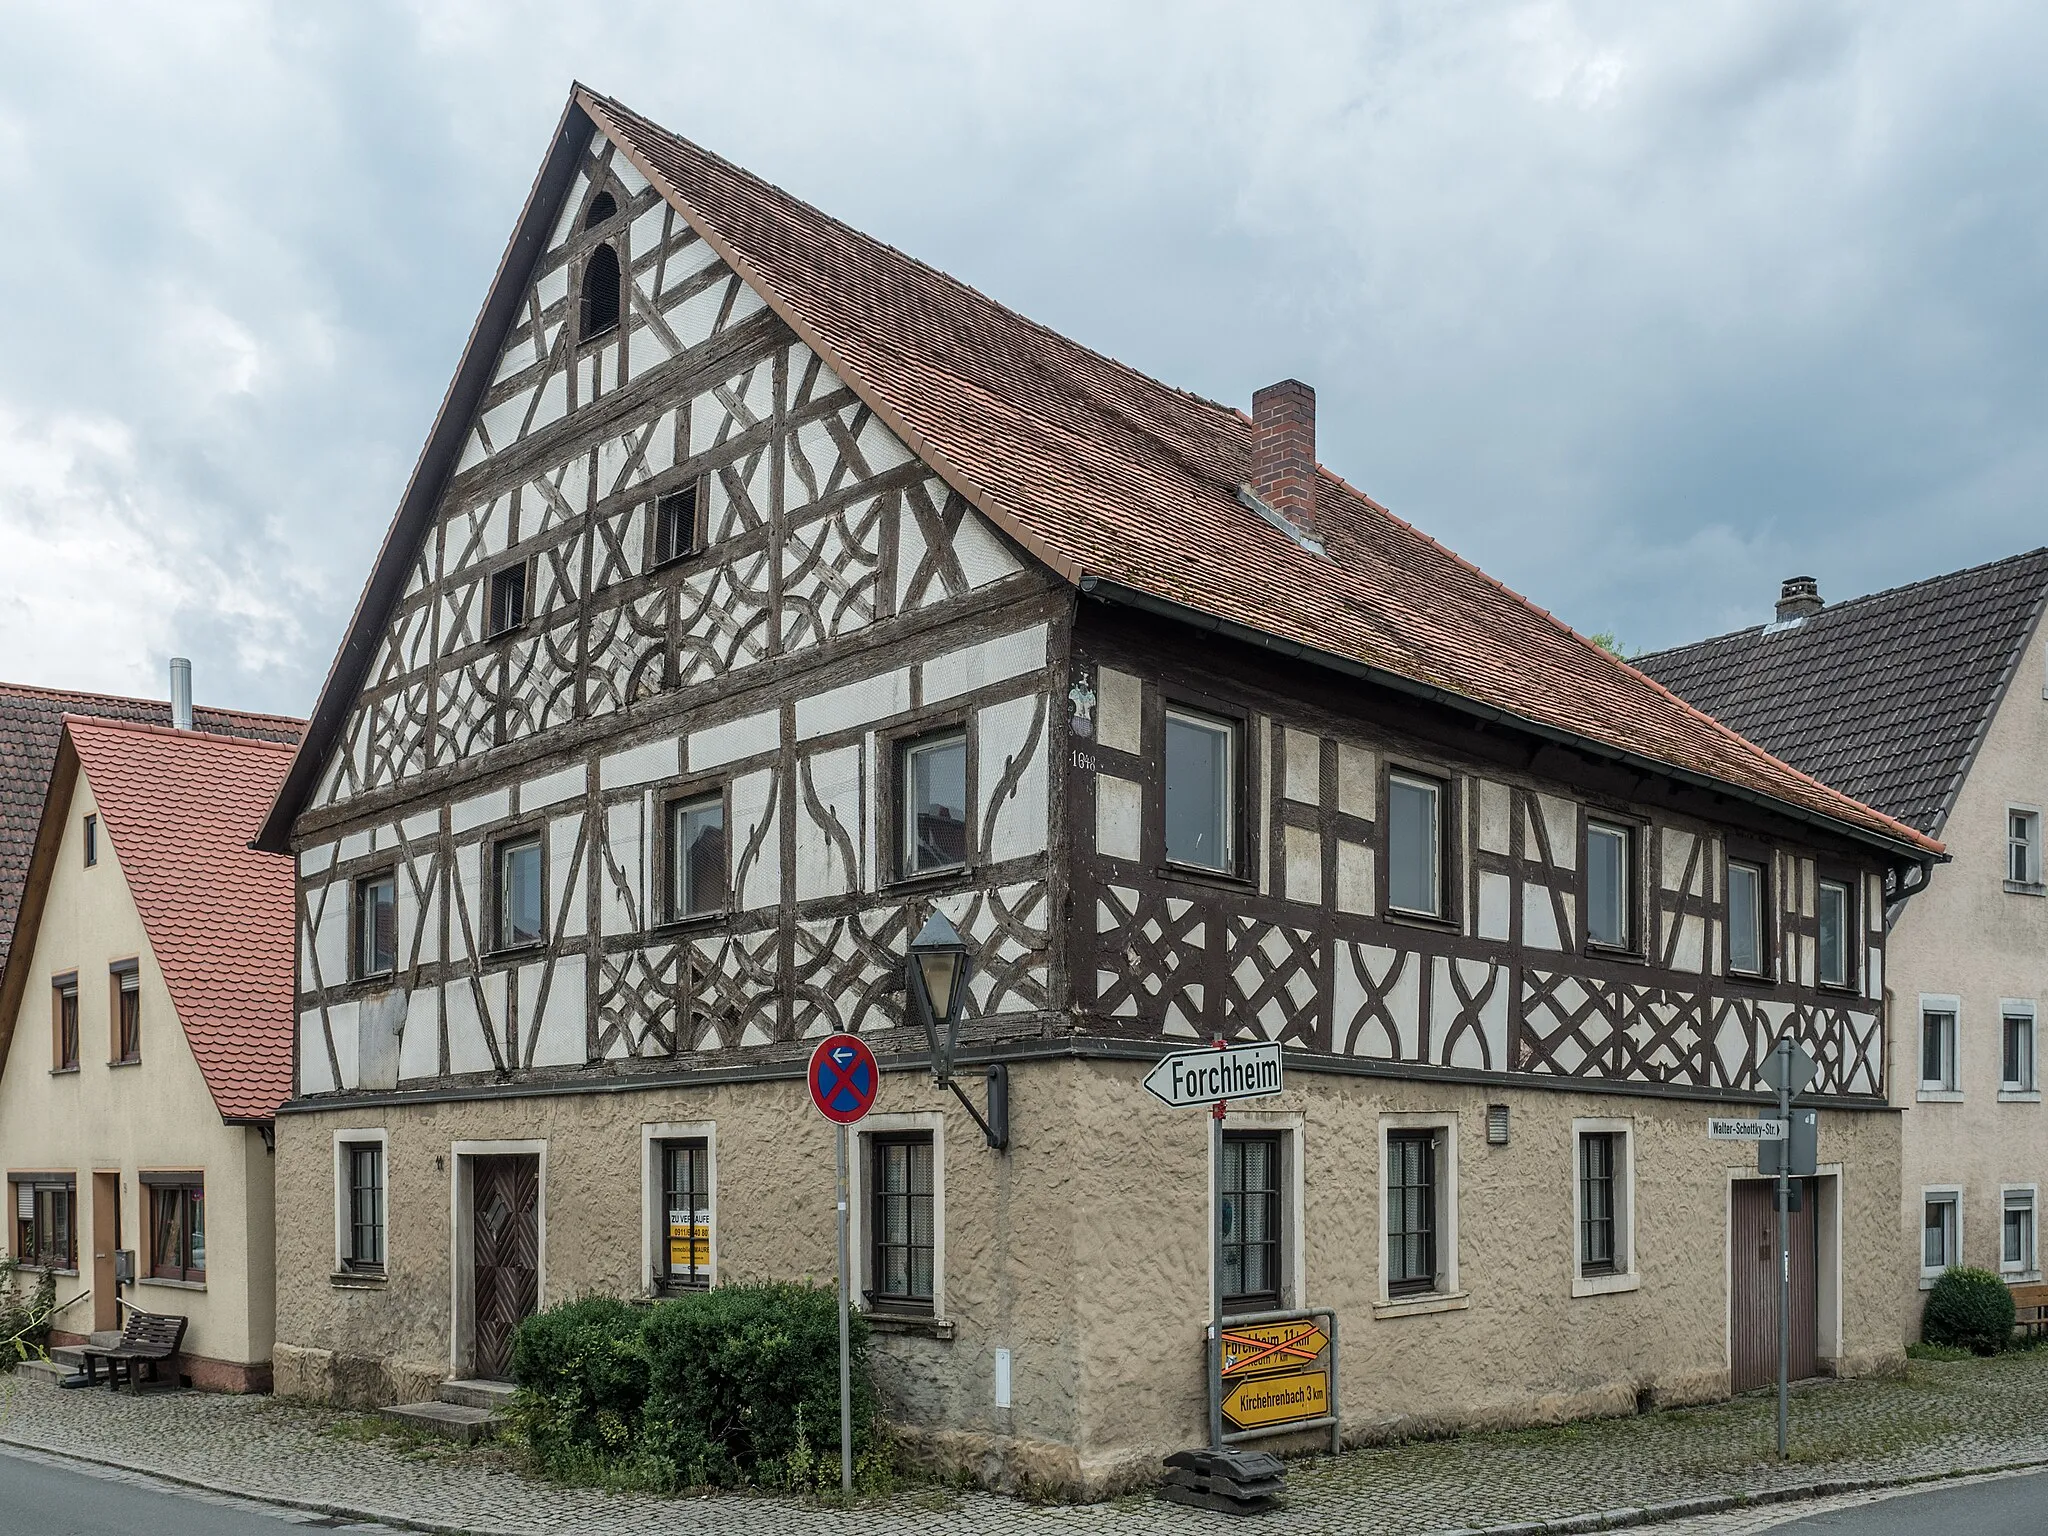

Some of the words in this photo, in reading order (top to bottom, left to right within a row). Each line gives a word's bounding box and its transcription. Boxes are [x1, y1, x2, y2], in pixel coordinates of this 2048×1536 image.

[1072, 750, 1096, 772] 1648
[1172, 1052, 1278, 1100] Forchheim
[1712, 1121, 1776, 1138] Walter-Schottky-Str.
[1284, 1329, 1294, 1347] 11
[1240, 1386, 1305, 1412] Kirchehrenbach
[1306, 1385, 1312, 1401] 3
[1313, 1387, 1324, 1400] km
